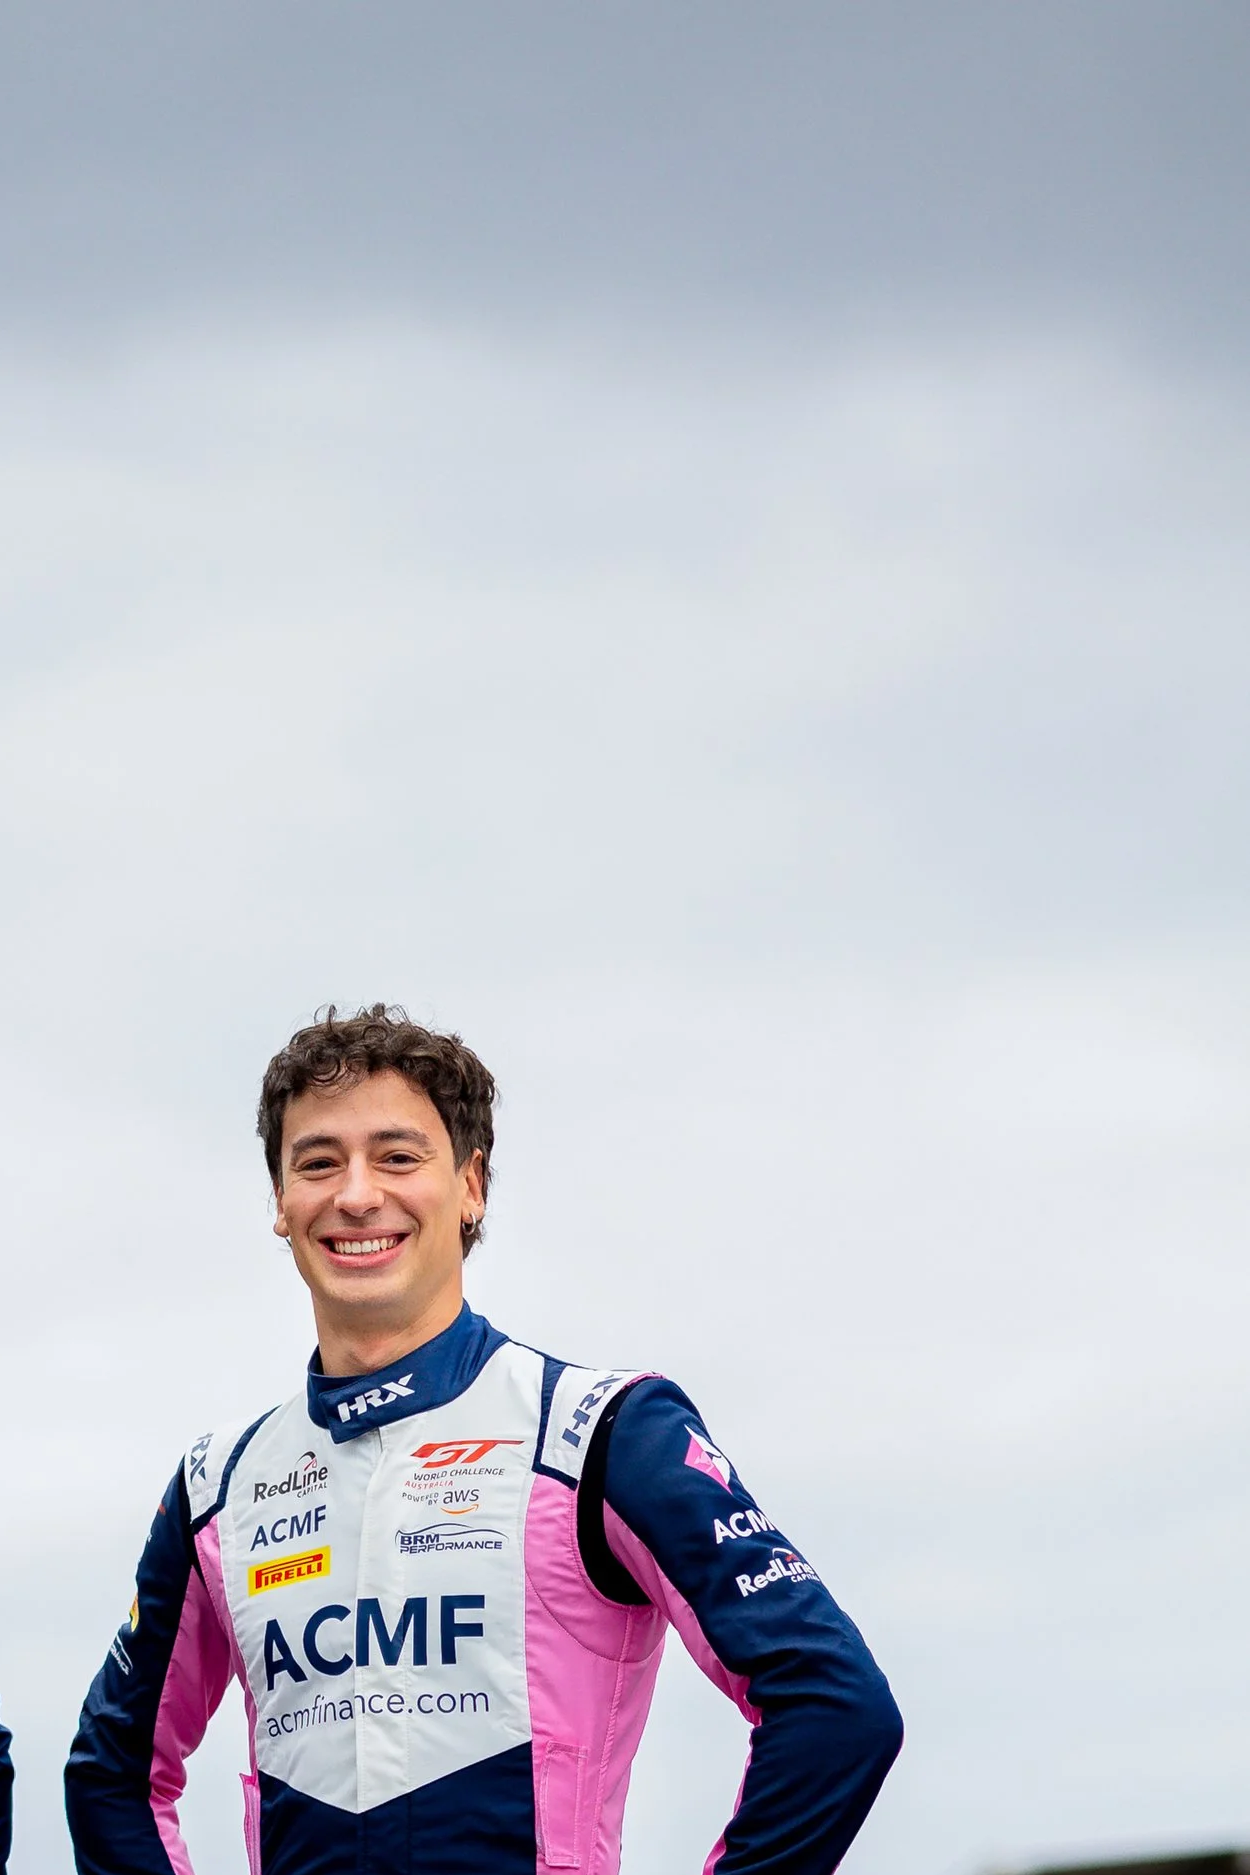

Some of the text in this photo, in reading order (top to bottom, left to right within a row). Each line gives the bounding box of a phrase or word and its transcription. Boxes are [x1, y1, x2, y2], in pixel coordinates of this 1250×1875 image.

[336, 1372, 416, 1423] HRX
[253, 1466, 329, 1504] RedLine
[296, 1481, 328, 1499] CAPITAL
[404, 1480, 454, 1490] AUSTRALIA
[413, 1467, 505, 1481] WORLD CHALLENGE
[443, 1489, 480, 1504] aws
[250, 1504, 327, 1552] ACMF
[400, 1533, 440, 1545] BRM
[713, 1509, 776, 1545] ACM
[400, 1541, 503, 1554] PERFORMANCE
[255, 1553, 324, 1590] PIRELLI
[735, 1558, 815, 1598] RedLine
[790, 1573, 820, 1583] CAPIT
[263, 1593, 486, 1691] ACMF
[266, 1688, 490, 1738] acmfinance.com
